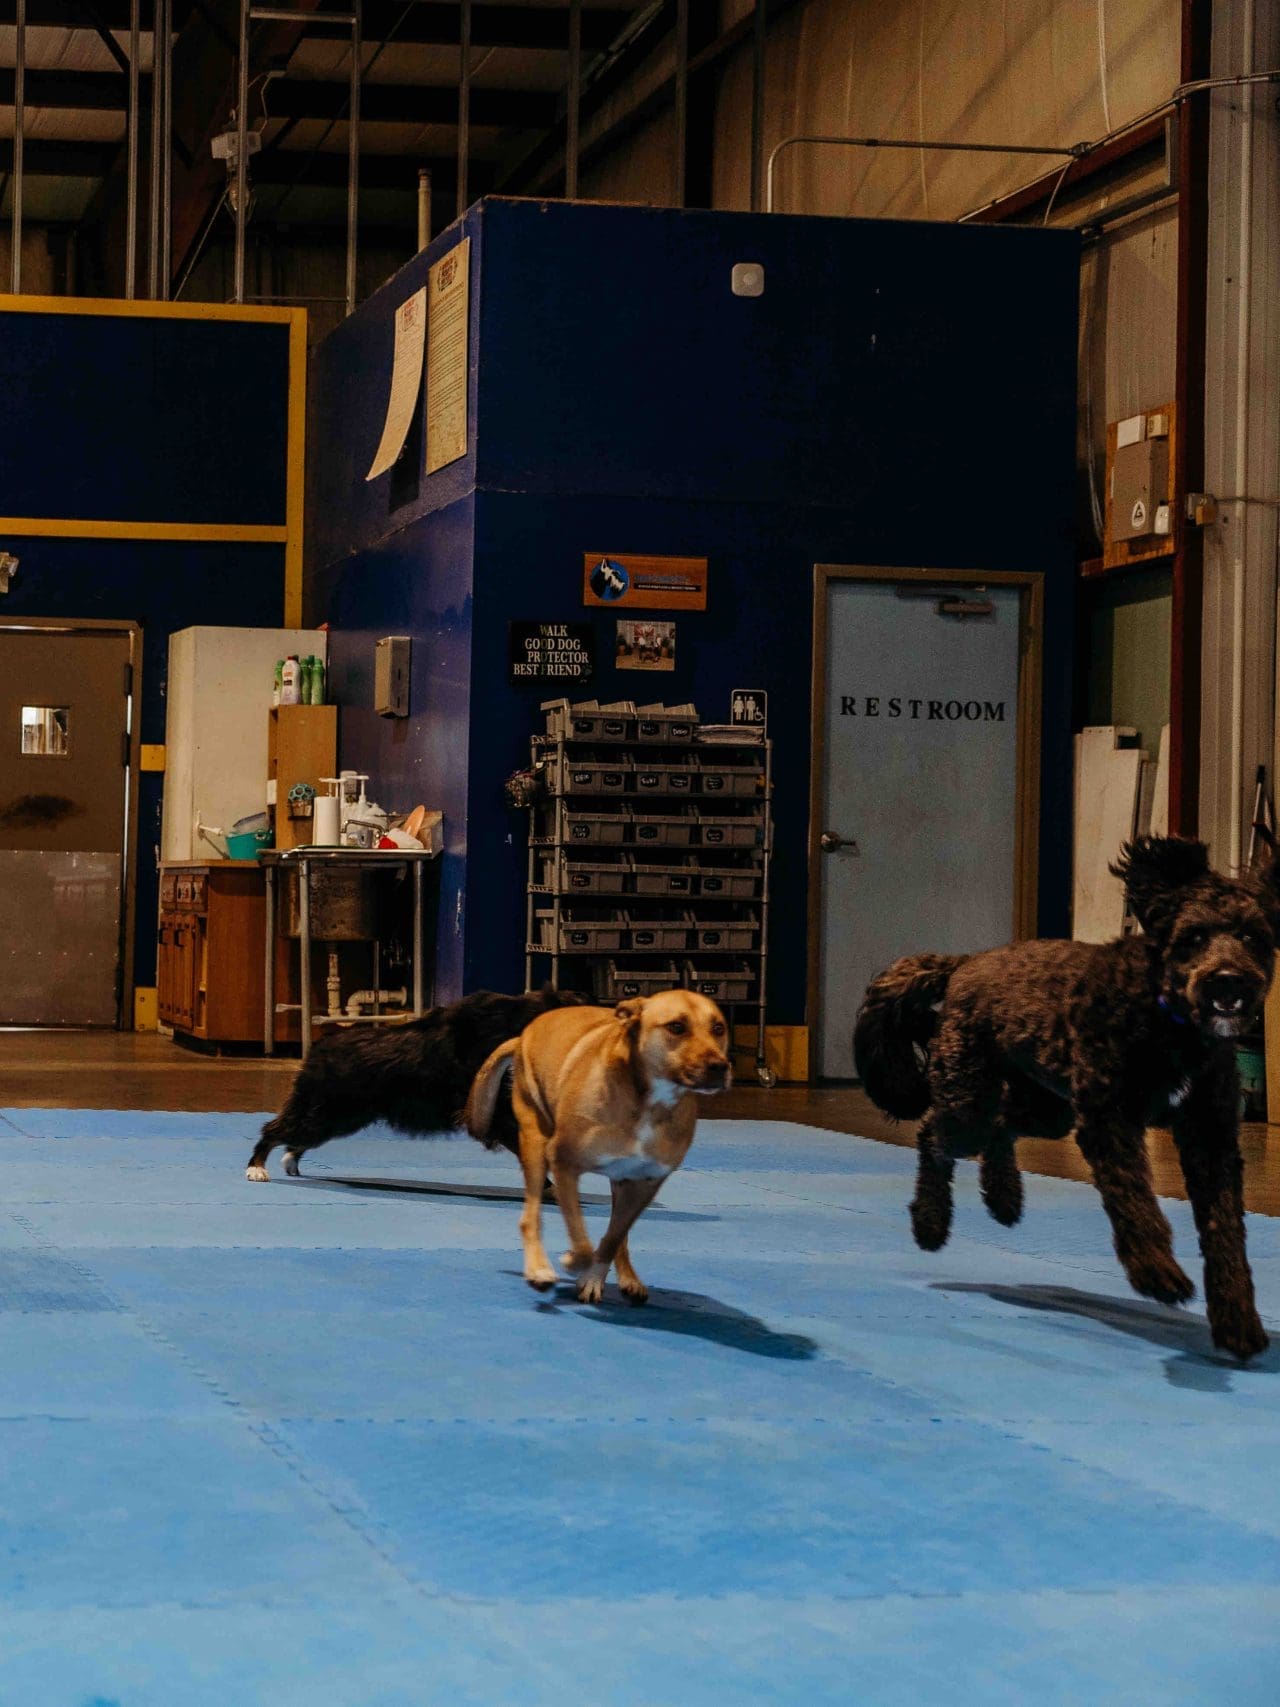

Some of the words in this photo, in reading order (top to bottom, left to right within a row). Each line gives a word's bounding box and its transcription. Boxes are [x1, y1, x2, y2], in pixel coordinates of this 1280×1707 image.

[540, 624, 568, 637] WALK
[525, 638, 555, 650] GOOD
[558, 638, 581, 650] DOG
[527, 651, 589, 663] PROTECTOR
[513, 663, 539, 675] BEST
[540, 664, 581, 676] FRIEND
[840, 696, 1006, 722] RESTROOM
